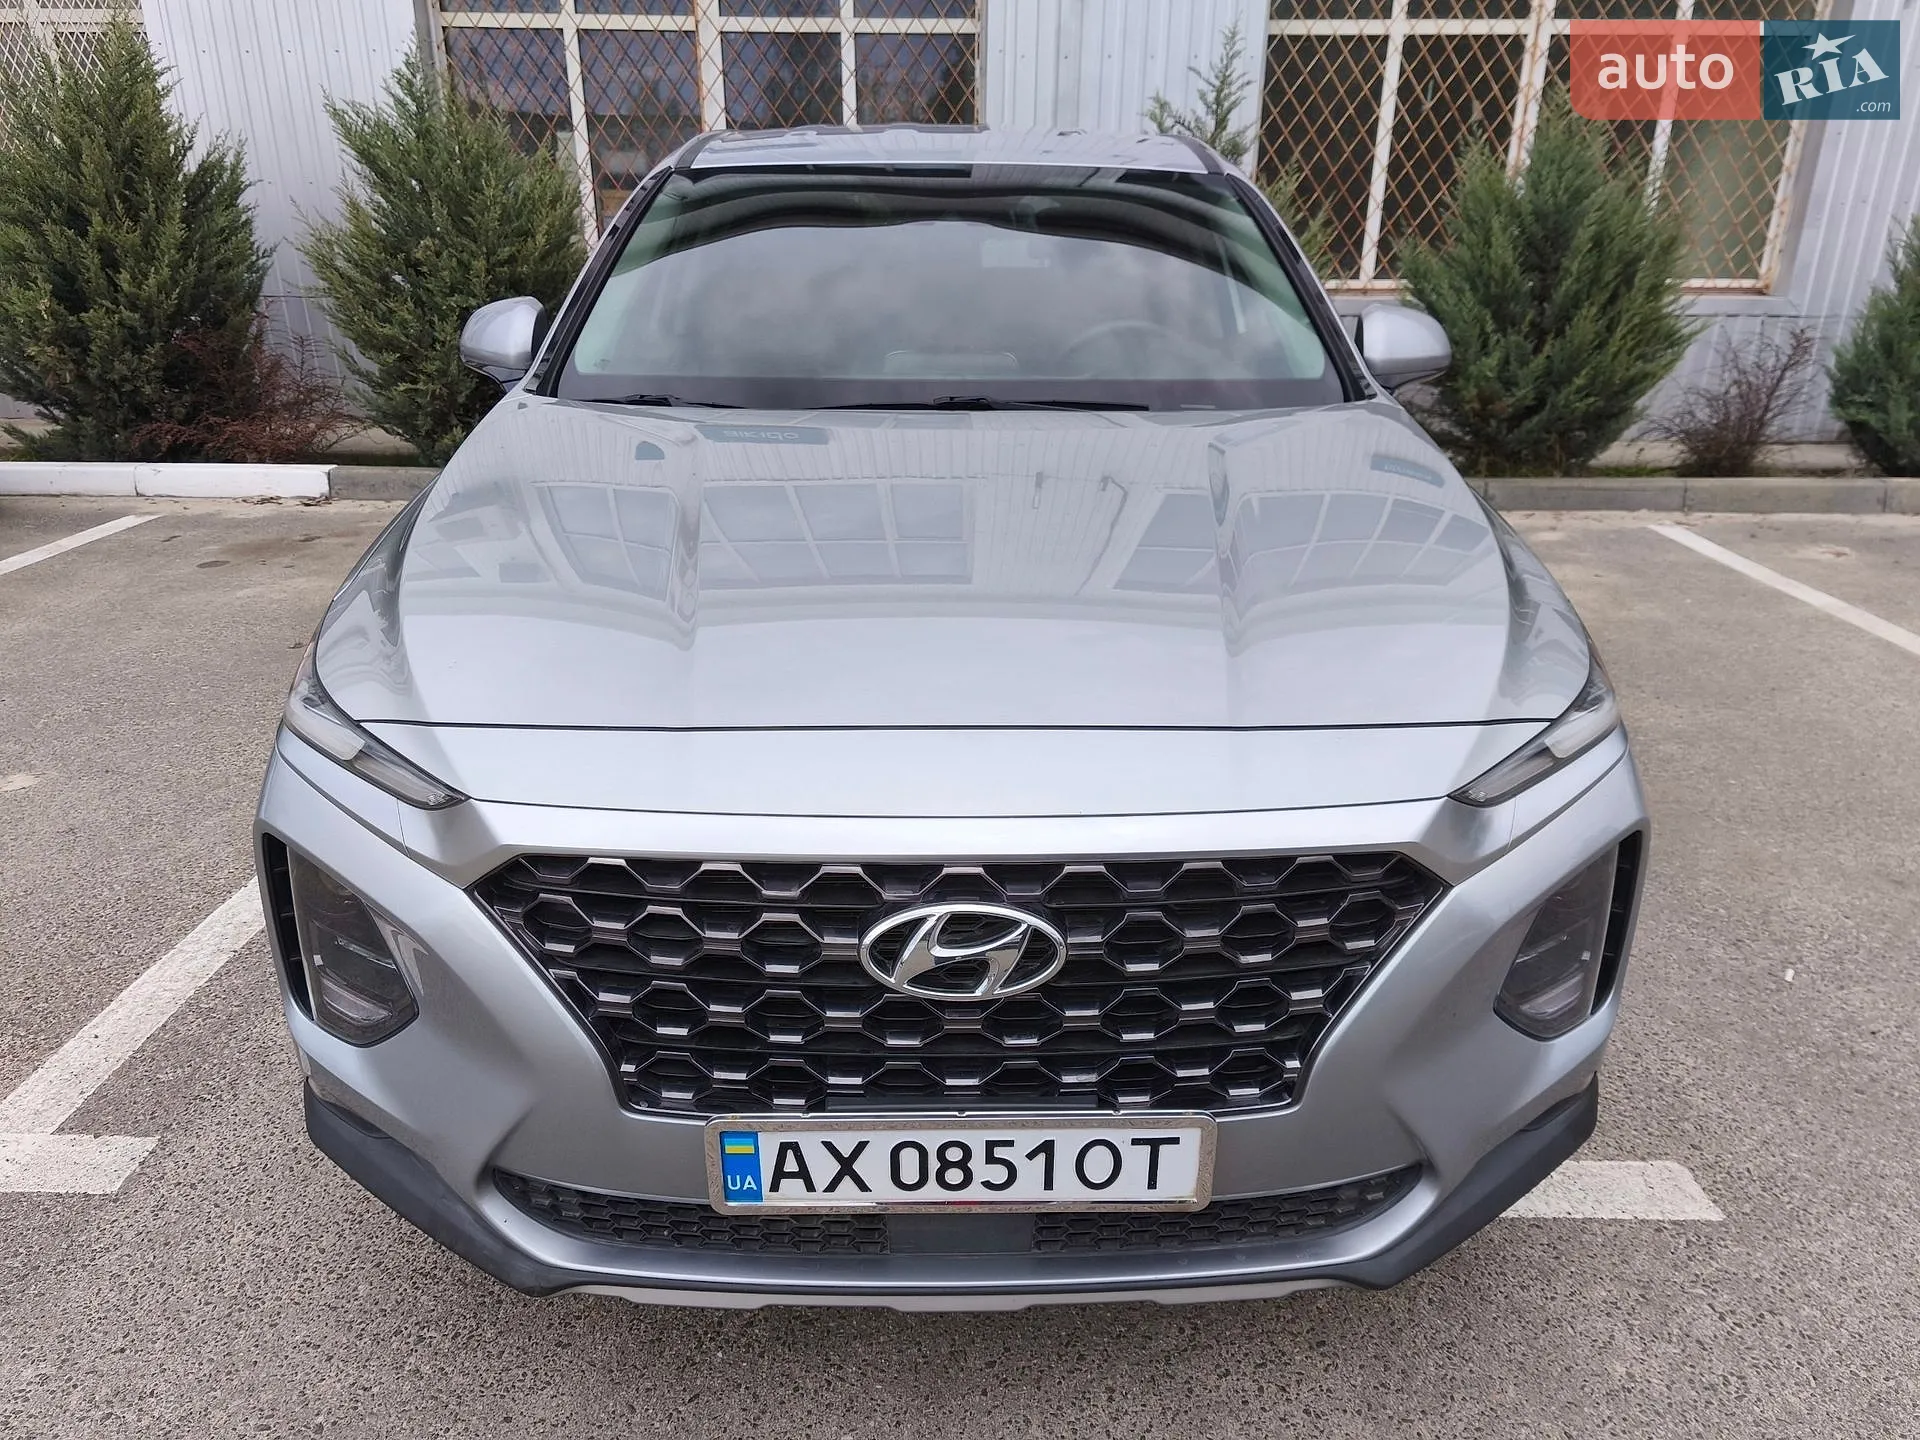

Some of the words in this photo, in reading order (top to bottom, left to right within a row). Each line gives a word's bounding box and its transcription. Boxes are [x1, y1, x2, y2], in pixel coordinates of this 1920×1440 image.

[727, 1174, 758, 1192] UA
[768, 1140, 870, 1193] AX
[889, 1139, 1056, 1193] 0851
[1075, 1136, 1181, 1191] OT
